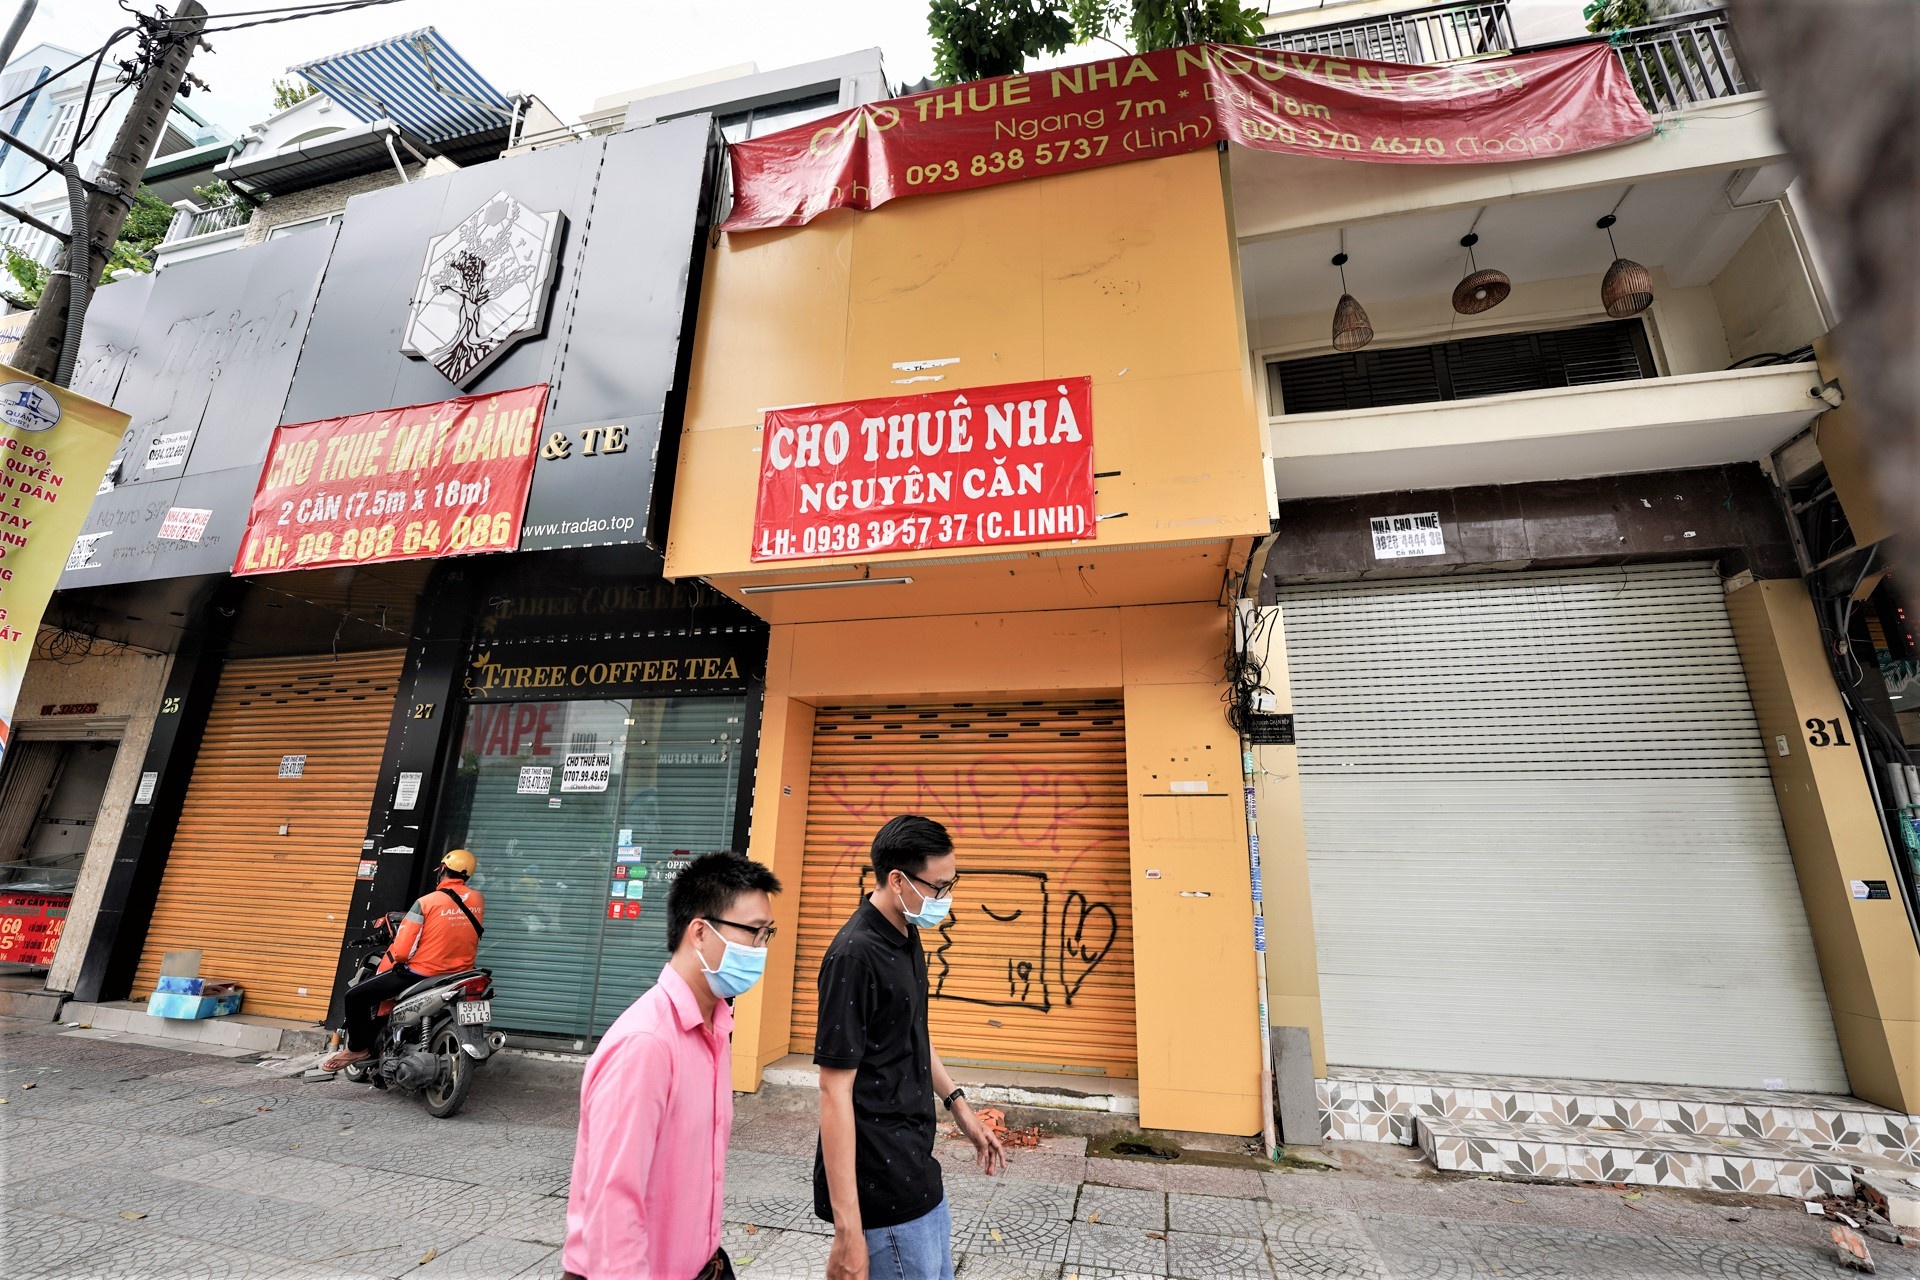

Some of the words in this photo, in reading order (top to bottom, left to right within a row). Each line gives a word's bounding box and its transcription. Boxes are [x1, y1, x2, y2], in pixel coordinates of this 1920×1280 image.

[913, 75, 1033, 123] THUÊ
[994, 106, 1105, 141] Ngang
[1116, 99, 1166, 121] 7m
[1268, 90, 1331, 120] 18m
[905, 164, 960, 186] 093
[969, 148, 1025, 177] 838
[1035, 136, 1110, 165] 5737
[1122, 116, 1213, 152] (Linh)
[1241, 119, 1296, 145] 090
[1306, 129, 1361, 152] 370
[1370, 136, 1446, 155] 4670
[1455, 130, 1566, 156] (Toàn)
[769, 420, 850, 471] CHO
[860, 394, 973, 462] THUÊ
[984, 384, 1083, 450] NHÀ
[21, 444, 51, 466] BỘ,
[266, 438, 318, 491] CHO
[319, 421, 390, 482] THUÊ
[388, 413, 453, 480] MẶT
[540, 431, 571, 460] &
[6, 458, 63, 487] QUYỀN
[799, 464, 953, 514] NGUYÊN
[962, 455, 1044, 500] CĂN
[19, 482, 57, 503] DÂN
[278, 501, 292, 526] 2
[296, 491, 342, 524] CĂN
[346, 489, 405, 522] (7.5m
[435, 476, 491, 509] 18m)
[0, 510, 32, 529] TAY
[522, 516, 635, 538] www.tradao.top
[762, 528, 796, 556] LH:
[802, 522, 860, 553] 0938
[867, 519, 895, 549] 38
[902, 517, 931, 544] 57
[938, 514, 968, 543] 37
[976, 504, 1085, 543] (C.LINH)
[1371, 517, 1391, 533] NHÀ
[1393, 517, 1412, 532] CHO
[1413, 512, 1438, 530] THUÊ
[244, 536, 285, 570] LH:
[295, 532, 333, 564] 09
[338, 524, 395, 561] 888
[402, 519, 441, 551] 64
[449, 511, 512, 550] 086
[1402, 533, 1427, 548] 4444
[1429, 531, 1443, 546] 36
[1408, 548, 1424, 556] MAI
[570, 659, 679, 687] COFFEE
[685, 656, 740, 680] TEA
[161, 697, 181, 714] 25
[413, 703, 435, 719] 27
[1805, 717, 1851, 748] 31
[531, 767, 542, 775] THUÊ
[566, 756, 579, 767] CHO
[580, 753, 595, 767] THUÊ
[596, 754, 610, 767] NHÀ
[563, 770, 609, 782] 0707.99.49.69
[460, 1011, 490, 1024] 051.43
